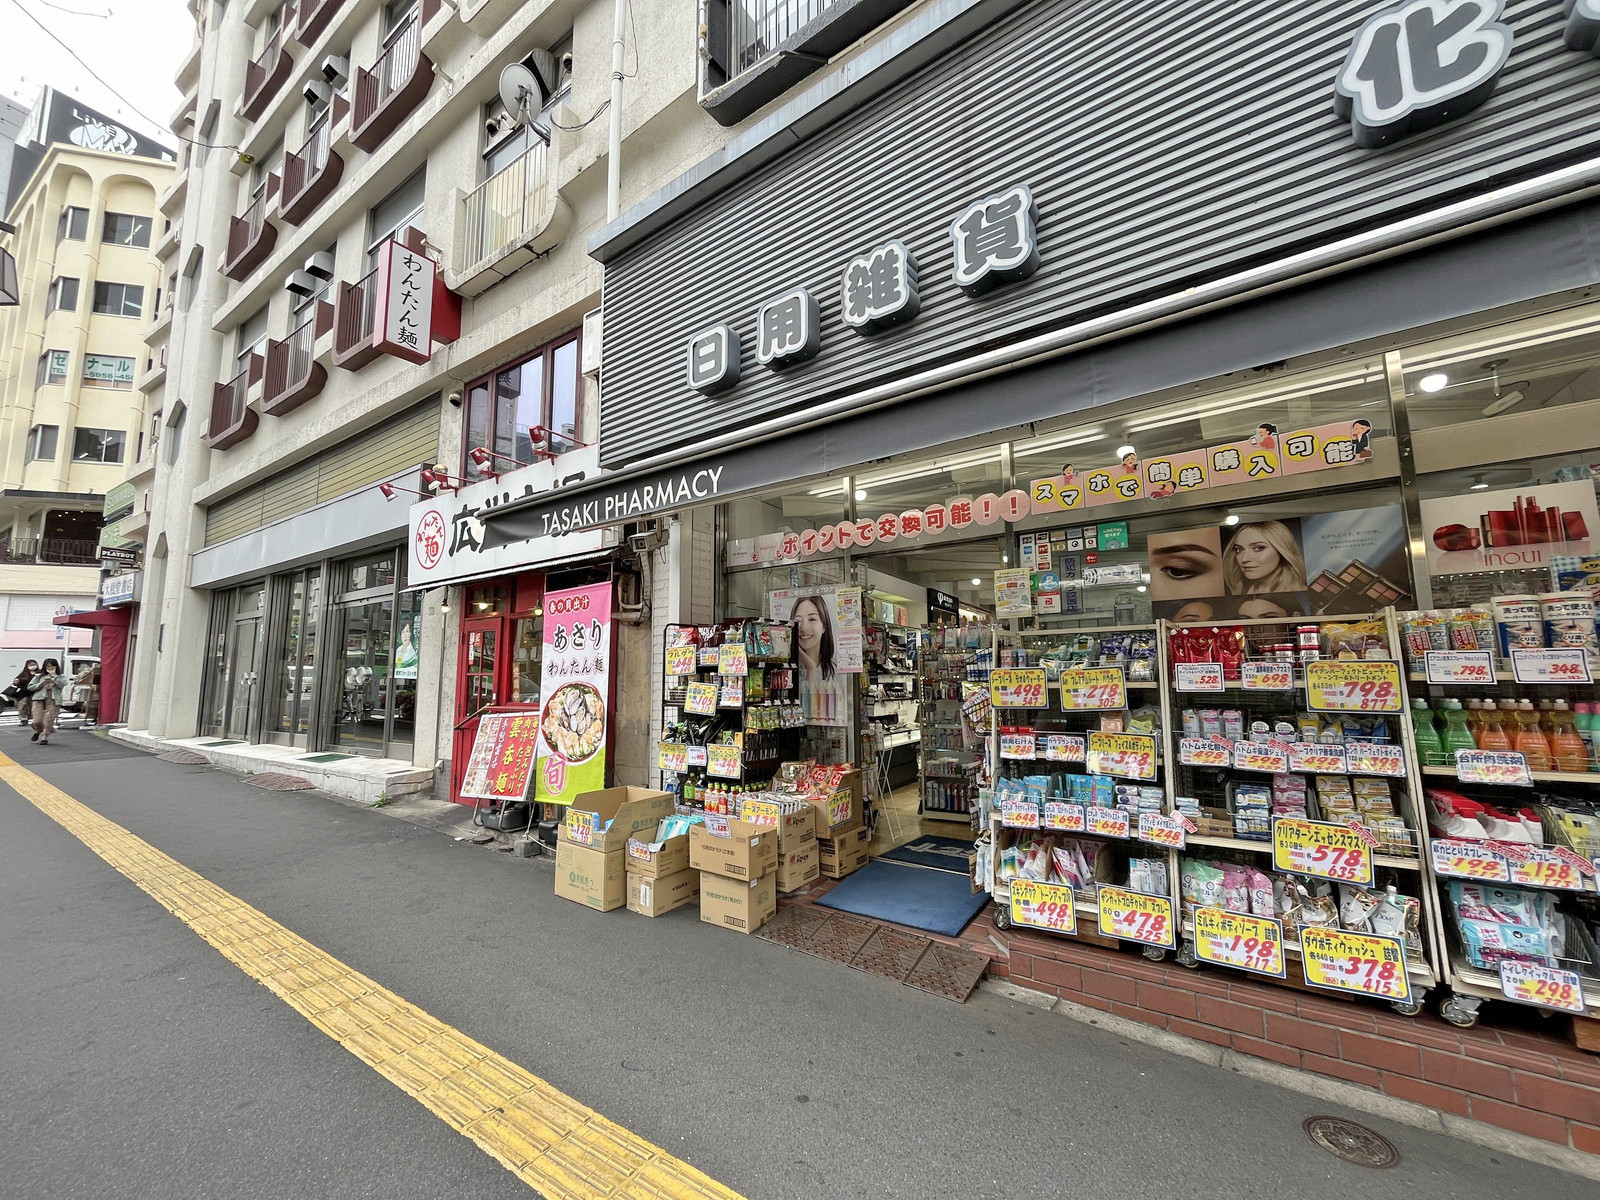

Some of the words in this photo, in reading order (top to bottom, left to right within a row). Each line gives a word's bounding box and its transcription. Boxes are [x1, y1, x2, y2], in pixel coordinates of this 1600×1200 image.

[397, 254, 423, 350] わんたん麺
[1036, 435, 1356, 507] スマホで簡単購入可能
[541, 501, 601, 534] TASAKI
[605, 466, 723, 519] PHARMACY
[102, 551, 134, 559] PLAYBOY
[554, 619, 602, 651] あさり
[549, 658, 604, 677] わんたん麺
[676, 656, 693, 668] 648
[1548, 664, 1579, 674] 348
[1459, 665, 1485, 675] 798
[1261, 673, 1288, 683] 698
[1013, 684, 1042, 697] 498
[1087, 683, 1120, 699] 278
[1344, 680, 1393, 698] 798
[1361, 698, 1388, 710] 877
[670, 754, 685, 764] 198
[721, 758, 737, 768] 248
[1248, 755, 1281, 765] 598
[1301, 756, 1341, 766] 498
[544, 757, 566, 789] 旬
[1015, 812, 1036, 822] 648
[1059, 815, 1082, 825] 698
[1101, 820, 1126, 831] 648
[1155, 828, 1180, 841] 248
[1312, 845, 1363, 867] 578
[1453, 857, 1500, 871] 198
[1535, 862, 1571, 880] 158
[1328, 865, 1356, 879] 635
[1036, 901, 1068, 918] 498
[1047, 917, 1065, 928] 547
[1123, 910, 1166, 931] 478
[1375, 912, 1394, 922] Dove
[1134, 928, 1162, 942] 525
[1230, 935, 1274, 957] 198
[1244, 955, 1269, 970] 217
[1345, 957, 1396, 980] 378
[1363, 978, 1392, 994] 415
[1535, 979, 1572, 1000] 298
